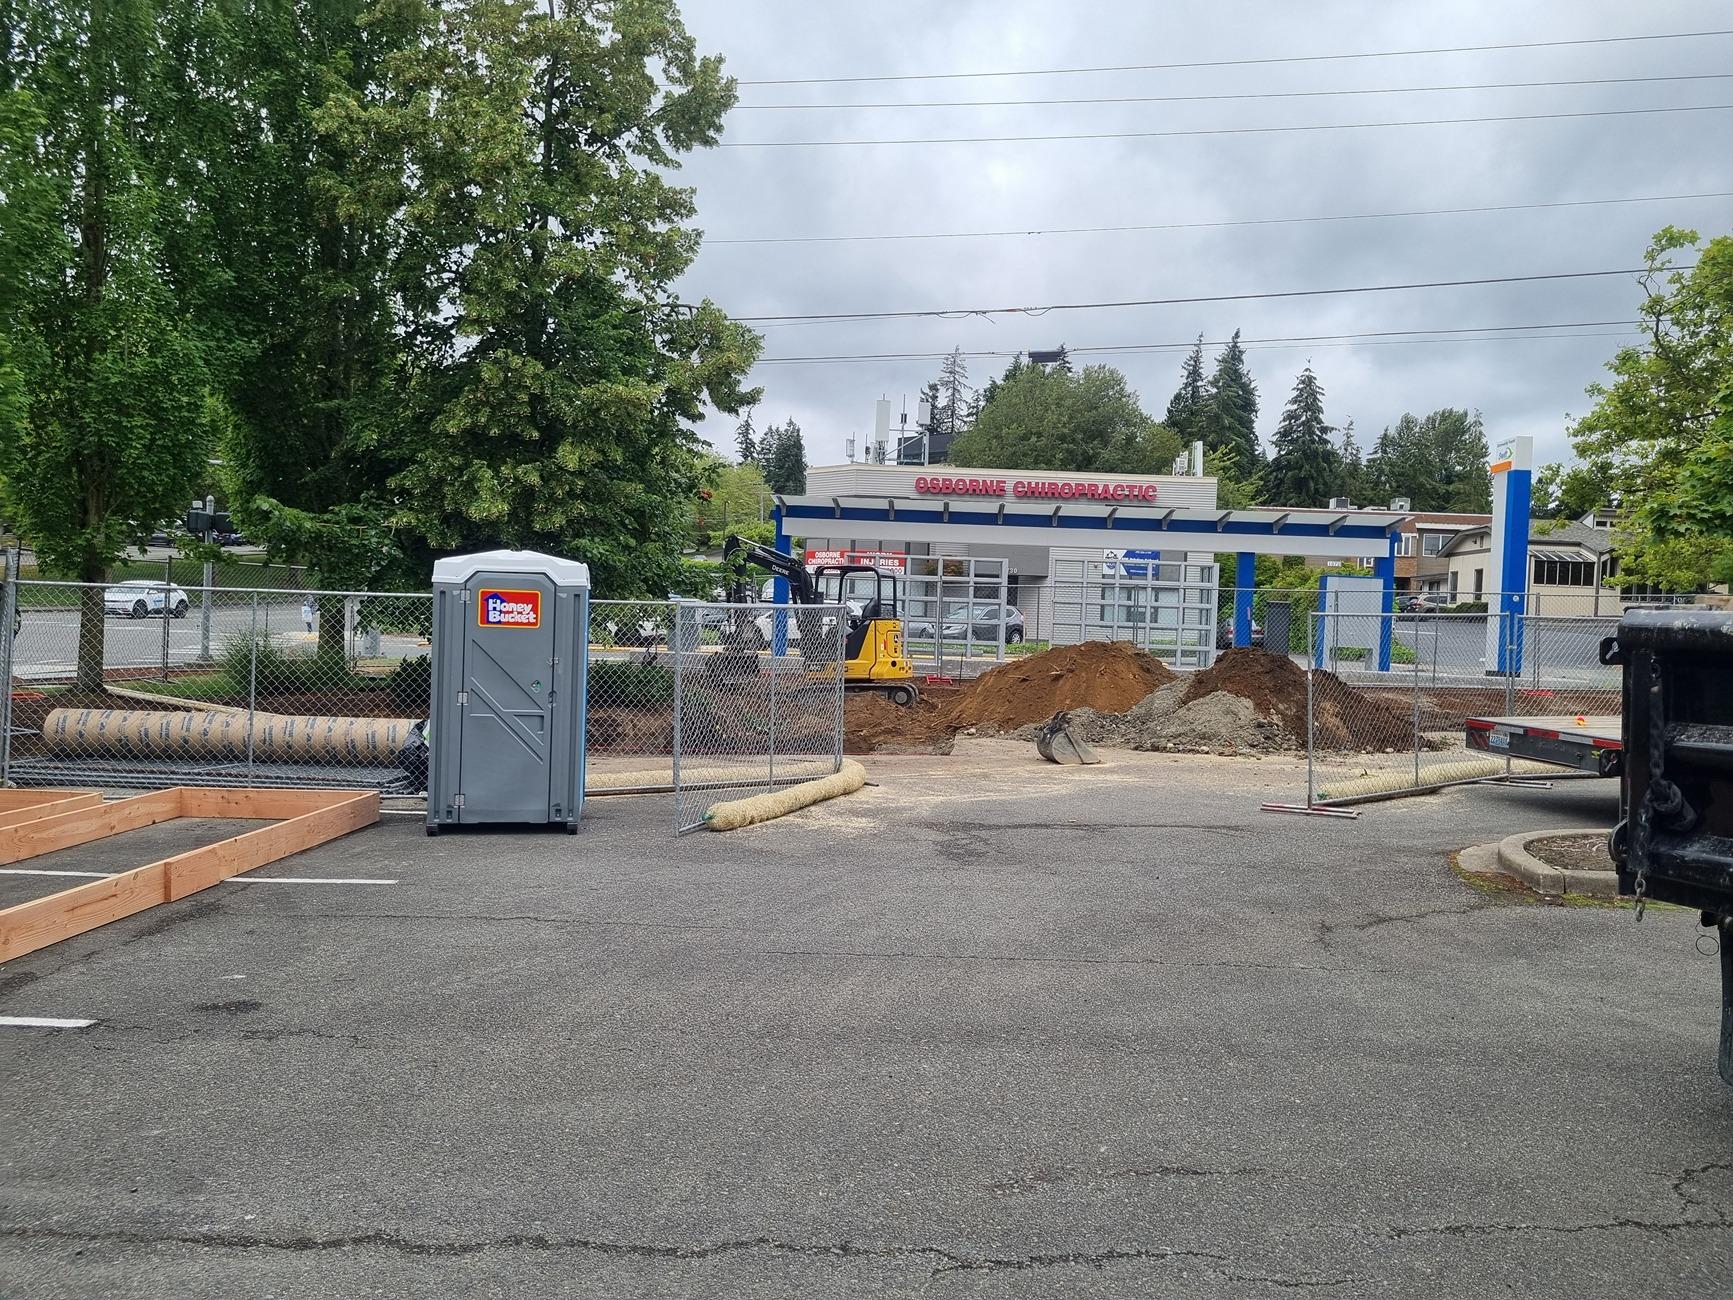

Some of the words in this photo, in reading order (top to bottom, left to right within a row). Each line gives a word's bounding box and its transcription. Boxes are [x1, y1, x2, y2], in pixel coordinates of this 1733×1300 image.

[914, 476, 1006, 496] OSBORNE
[1012, 480, 1157, 501] CHIROPRACTIC
[860, 558, 899, 566] INJRIES
[488, 598, 533, 615] Honey
[488, 610, 537, 623] Bucket
